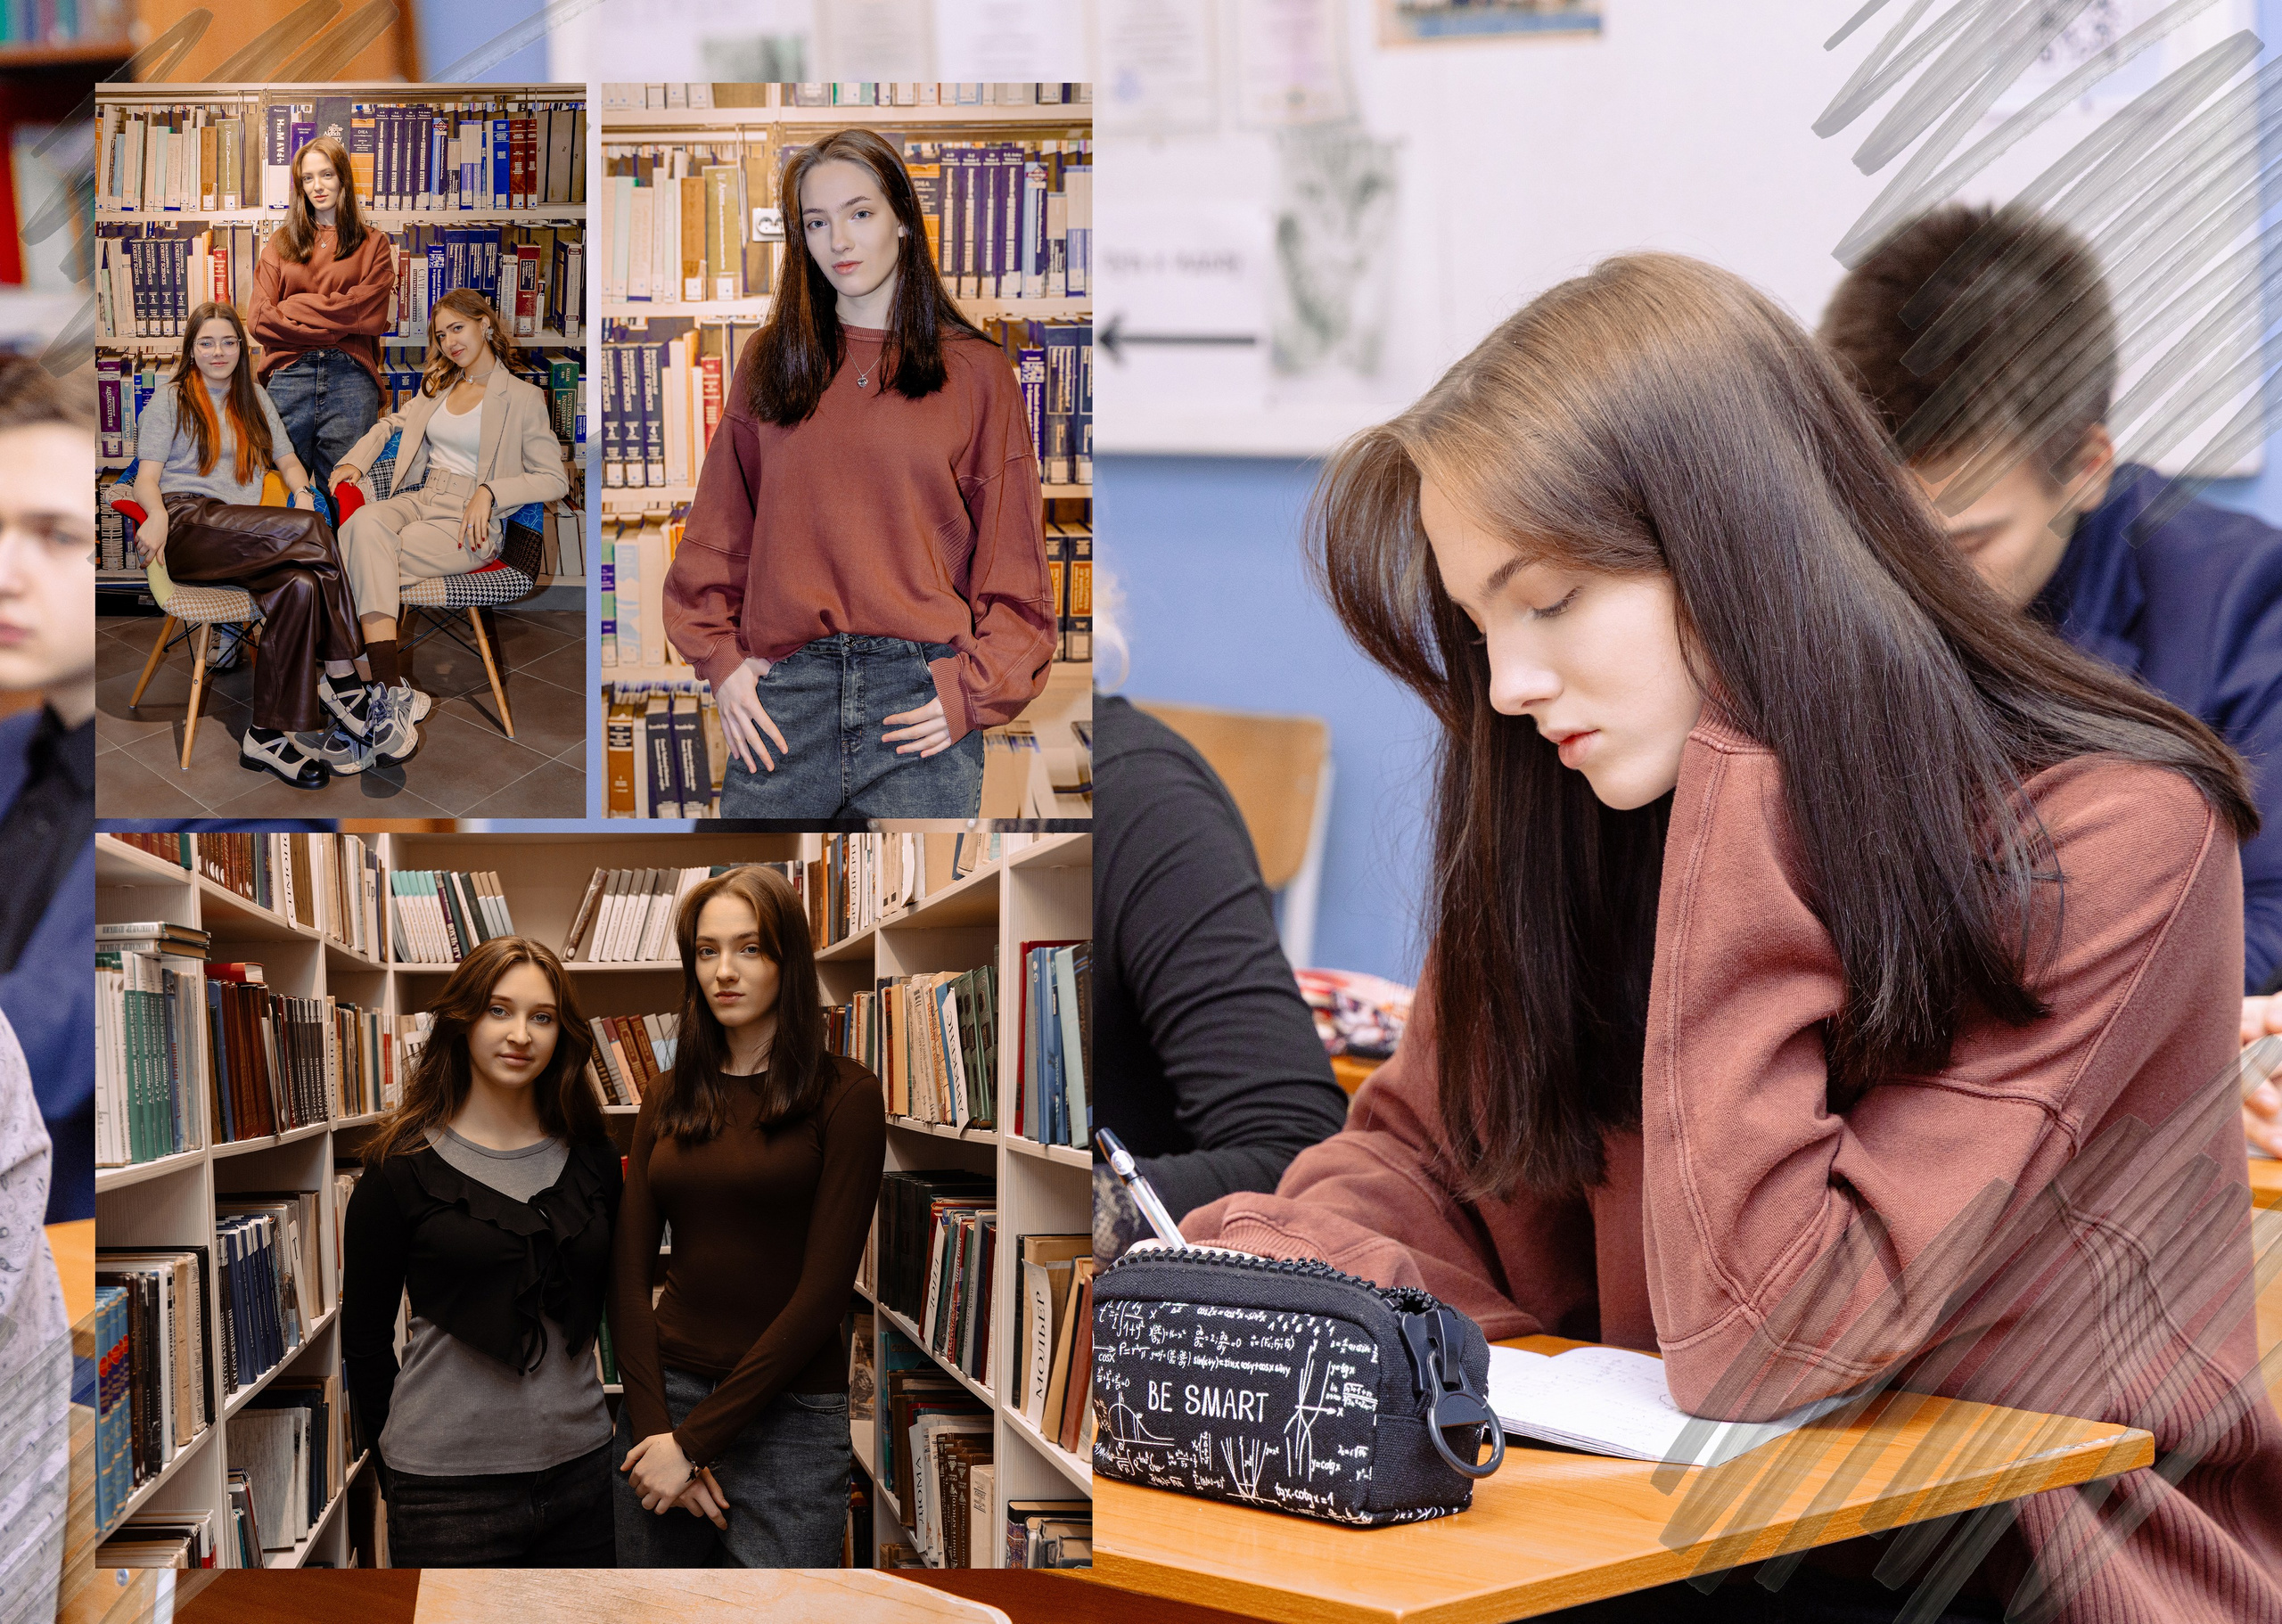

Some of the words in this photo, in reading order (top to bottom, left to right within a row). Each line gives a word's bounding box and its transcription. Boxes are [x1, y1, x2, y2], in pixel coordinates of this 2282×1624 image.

[930, 1259, 939, 1318] ДОЙЛ
[1036, 1291, 1045, 1399] МОЛЬЕР
[1148, 1380, 1173, 1413] BE
[1185, 1384, 1269, 1423] SMART
[915, 1456, 924, 1524] ДЮМА
